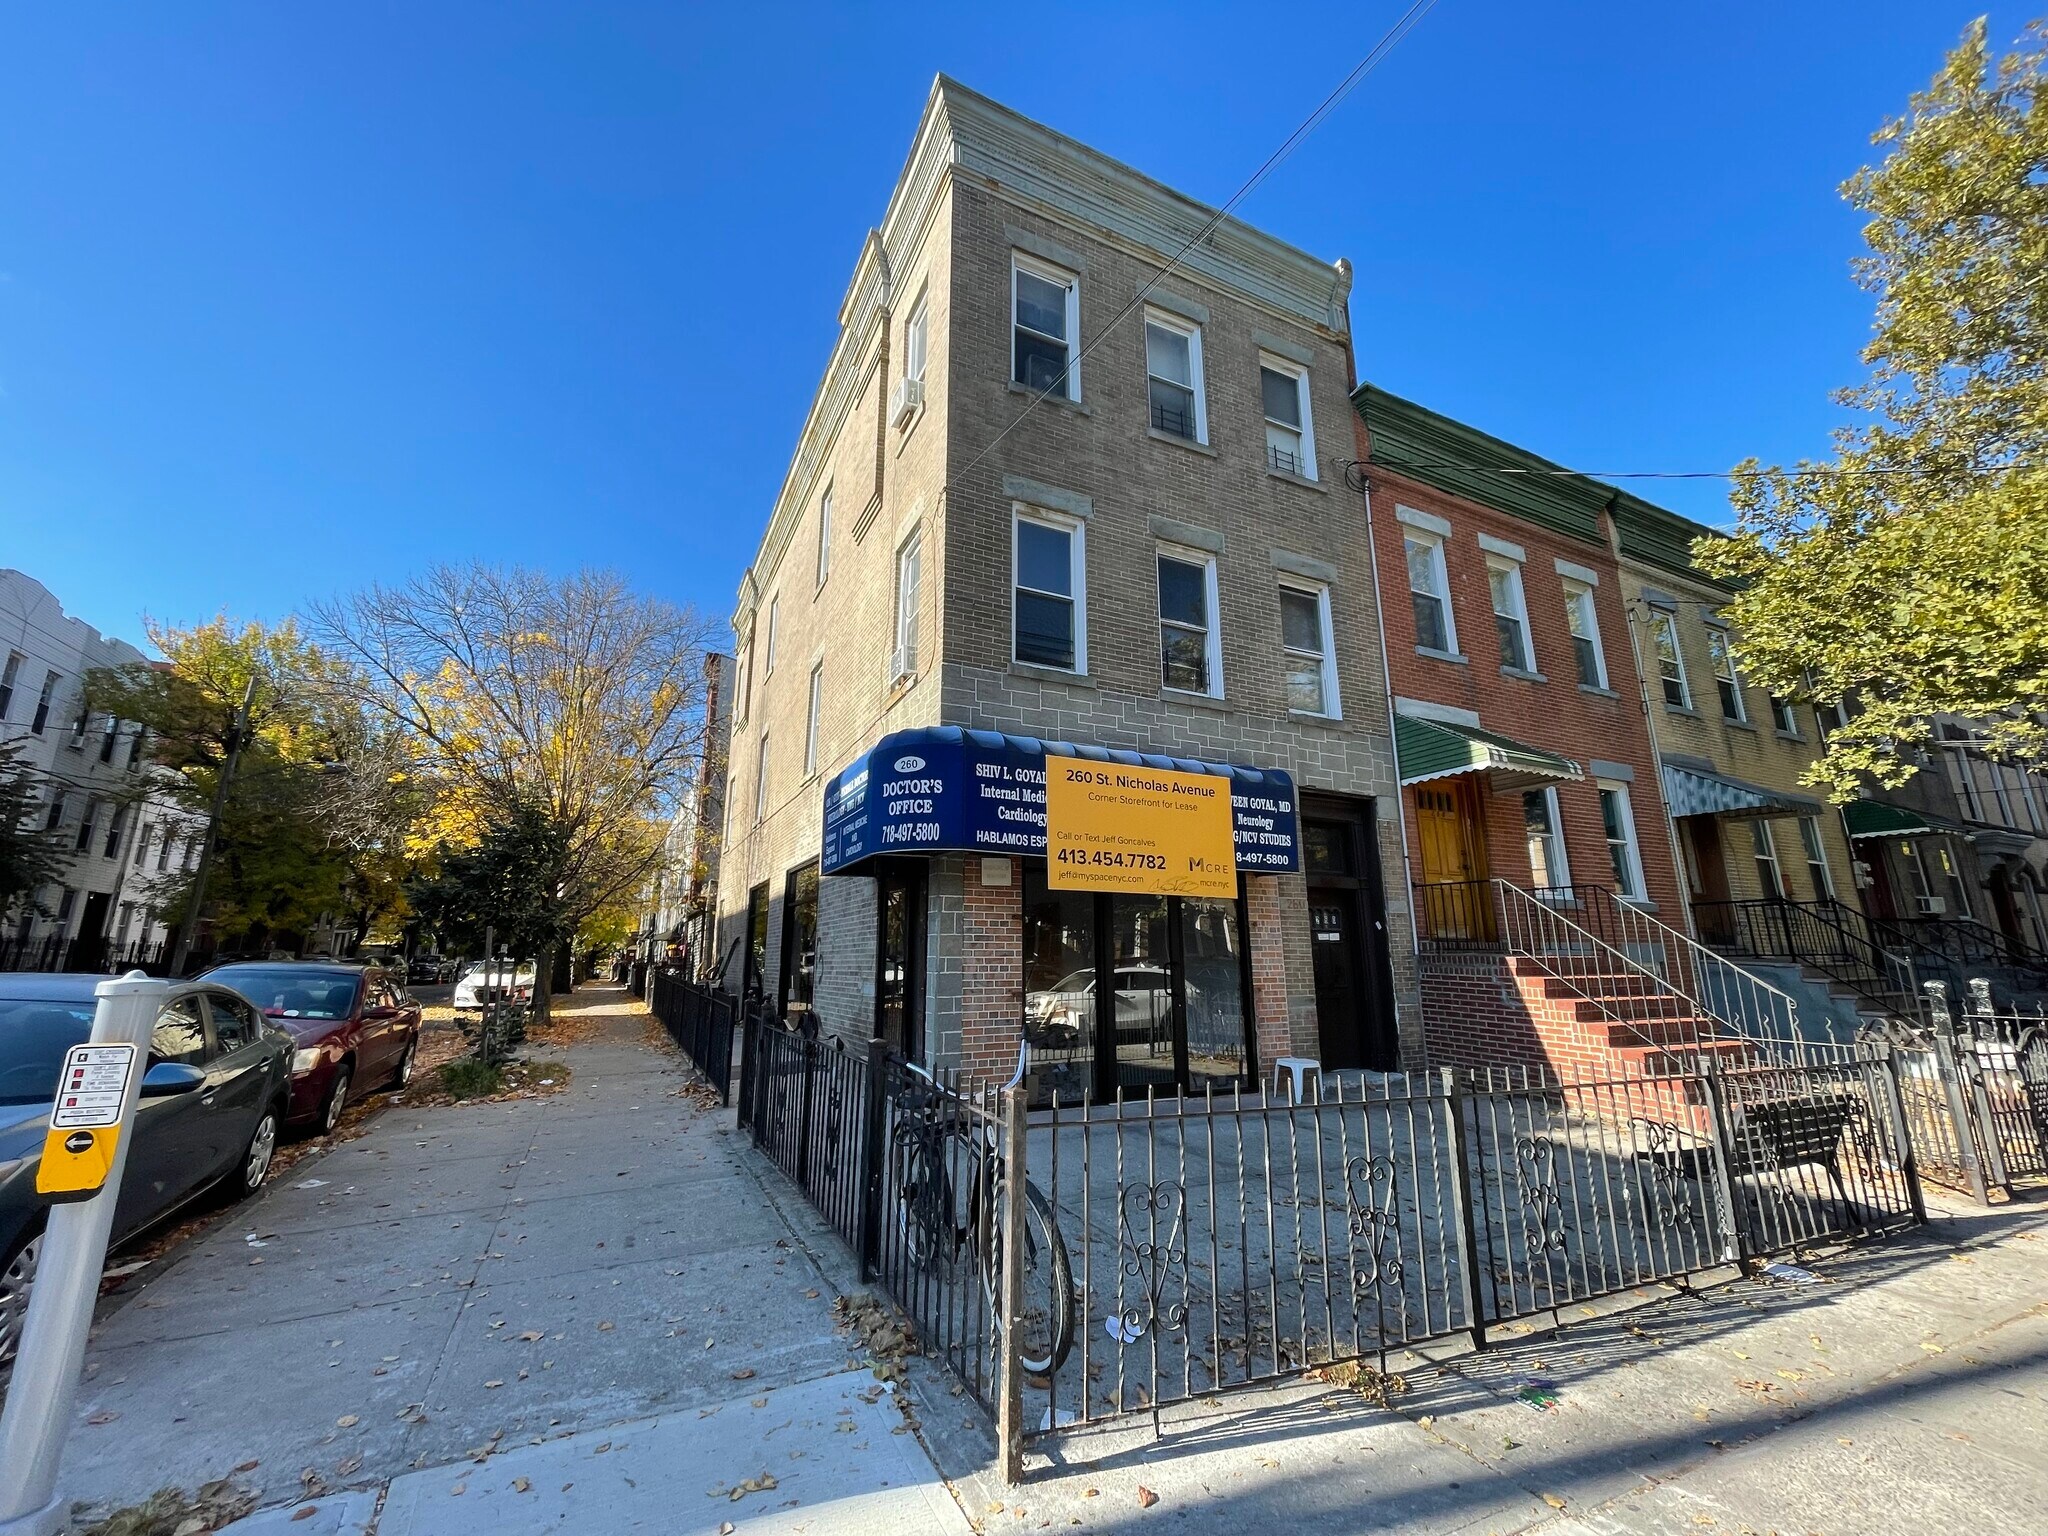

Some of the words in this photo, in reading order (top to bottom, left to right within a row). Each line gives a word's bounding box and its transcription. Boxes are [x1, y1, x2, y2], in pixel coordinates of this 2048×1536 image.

[900, 760, 918, 770] 260
[976, 763, 1001, 779] SHIV
[1003, 766, 1012, 780] L.
[1015, 768, 1046, 784] GOYAL
[883, 779, 943, 798] DOCTOR'S
[980, 784, 1020, 801] Internal
[1066, 770, 1092, 784] 260
[1096, 773, 1112, 786] St.
[1116, 776, 1168, 792] Nicholas
[1172, 782, 1216, 798] Avenue
[888, 800, 933, 816] OFFICE
[1088, 792, 1118, 804] Corner
[1119, 796, 1160, 808] Storefront
[1162, 798, 1173, 809] for
[1174, 801, 1198, 812] Lease
[1250, 798, 1278, 813] GOYAL,
[1278, 801, 1291, 812] MD
[998, 806, 1048, 827] Cardiology
[1237, 813, 1274, 830] Neurology
[882, 822, 940, 844] 718-497-5800
[976, 830, 1028, 846] HABLAMOS
[1030, 835, 1048, 848] ESP
[1056, 831, 1072, 840] Call
[1084, 833, 1100, 842] Text
[1101, 834, 1116, 844] Jeff
[1118, 836, 1156, 847] Goncalves
[1260, 832, 1292, 846] STUDIES
[1057, 848, 1166, 870] 413.454.7782
[1236, 852, 1288, 865] 8-497-5800
[1057, 870, 1144, 884] jeff@myspacenyc.com
